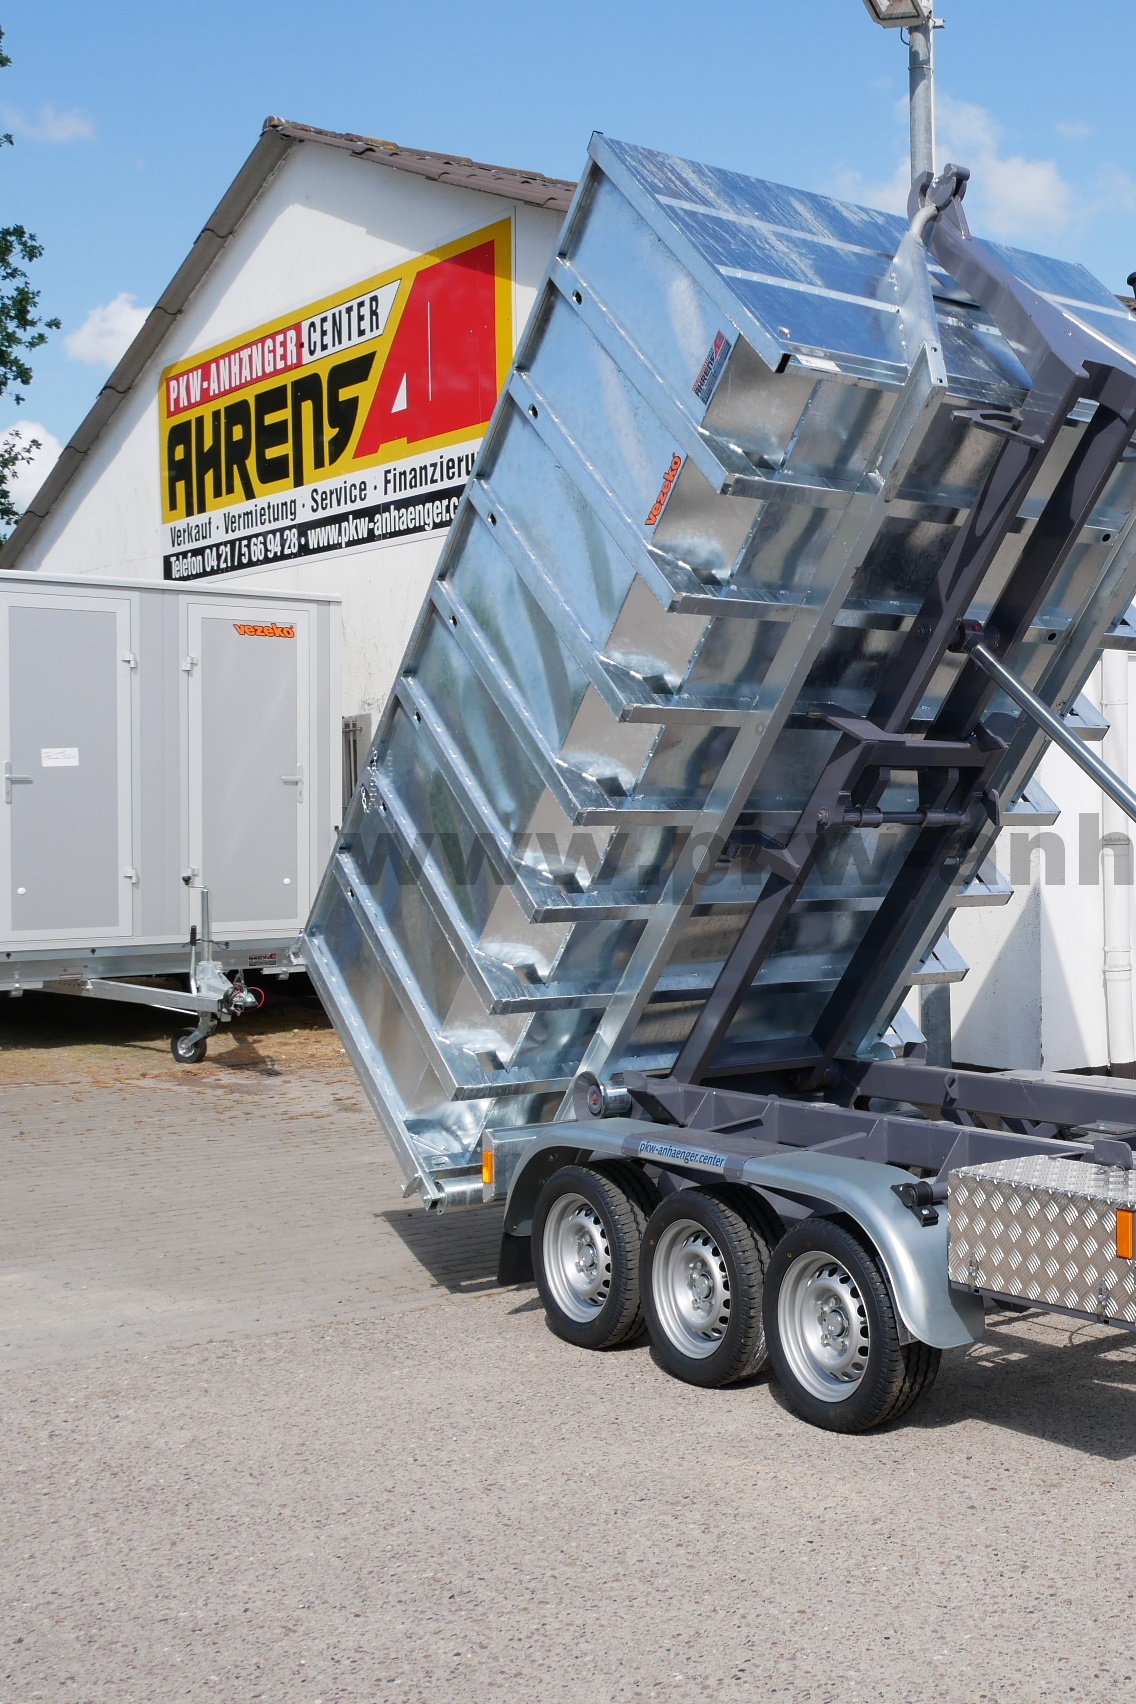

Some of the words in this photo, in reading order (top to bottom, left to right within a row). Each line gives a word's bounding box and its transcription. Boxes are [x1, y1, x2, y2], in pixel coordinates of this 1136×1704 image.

[167, 350, 378, 517] AHRENS
[170, 517, 212, 548] Verkauf
[223, 499, 297, 534] Vermietung
[310, 480, 368, 513] Service
[383, 451, 478, 496] Finanzieru
[645, 452, 682, 526] vezeko
[170, 552, 203, 579] Telefon
[204, 547, 217, 572] 04
[220, 544, 231, 569] 21
[241, 540, 249, 564] 5
[250, 535, 265, 562] 66
[266, 531, 281, 558] 94
[283, 528, 298, 555] 28
[307, 496, 462, 549] www.pkw-anhaenger.c
[232, 622, 295, 639] vezeko
[640, 1141, 725, 1167] pkw-anhaenger.center
